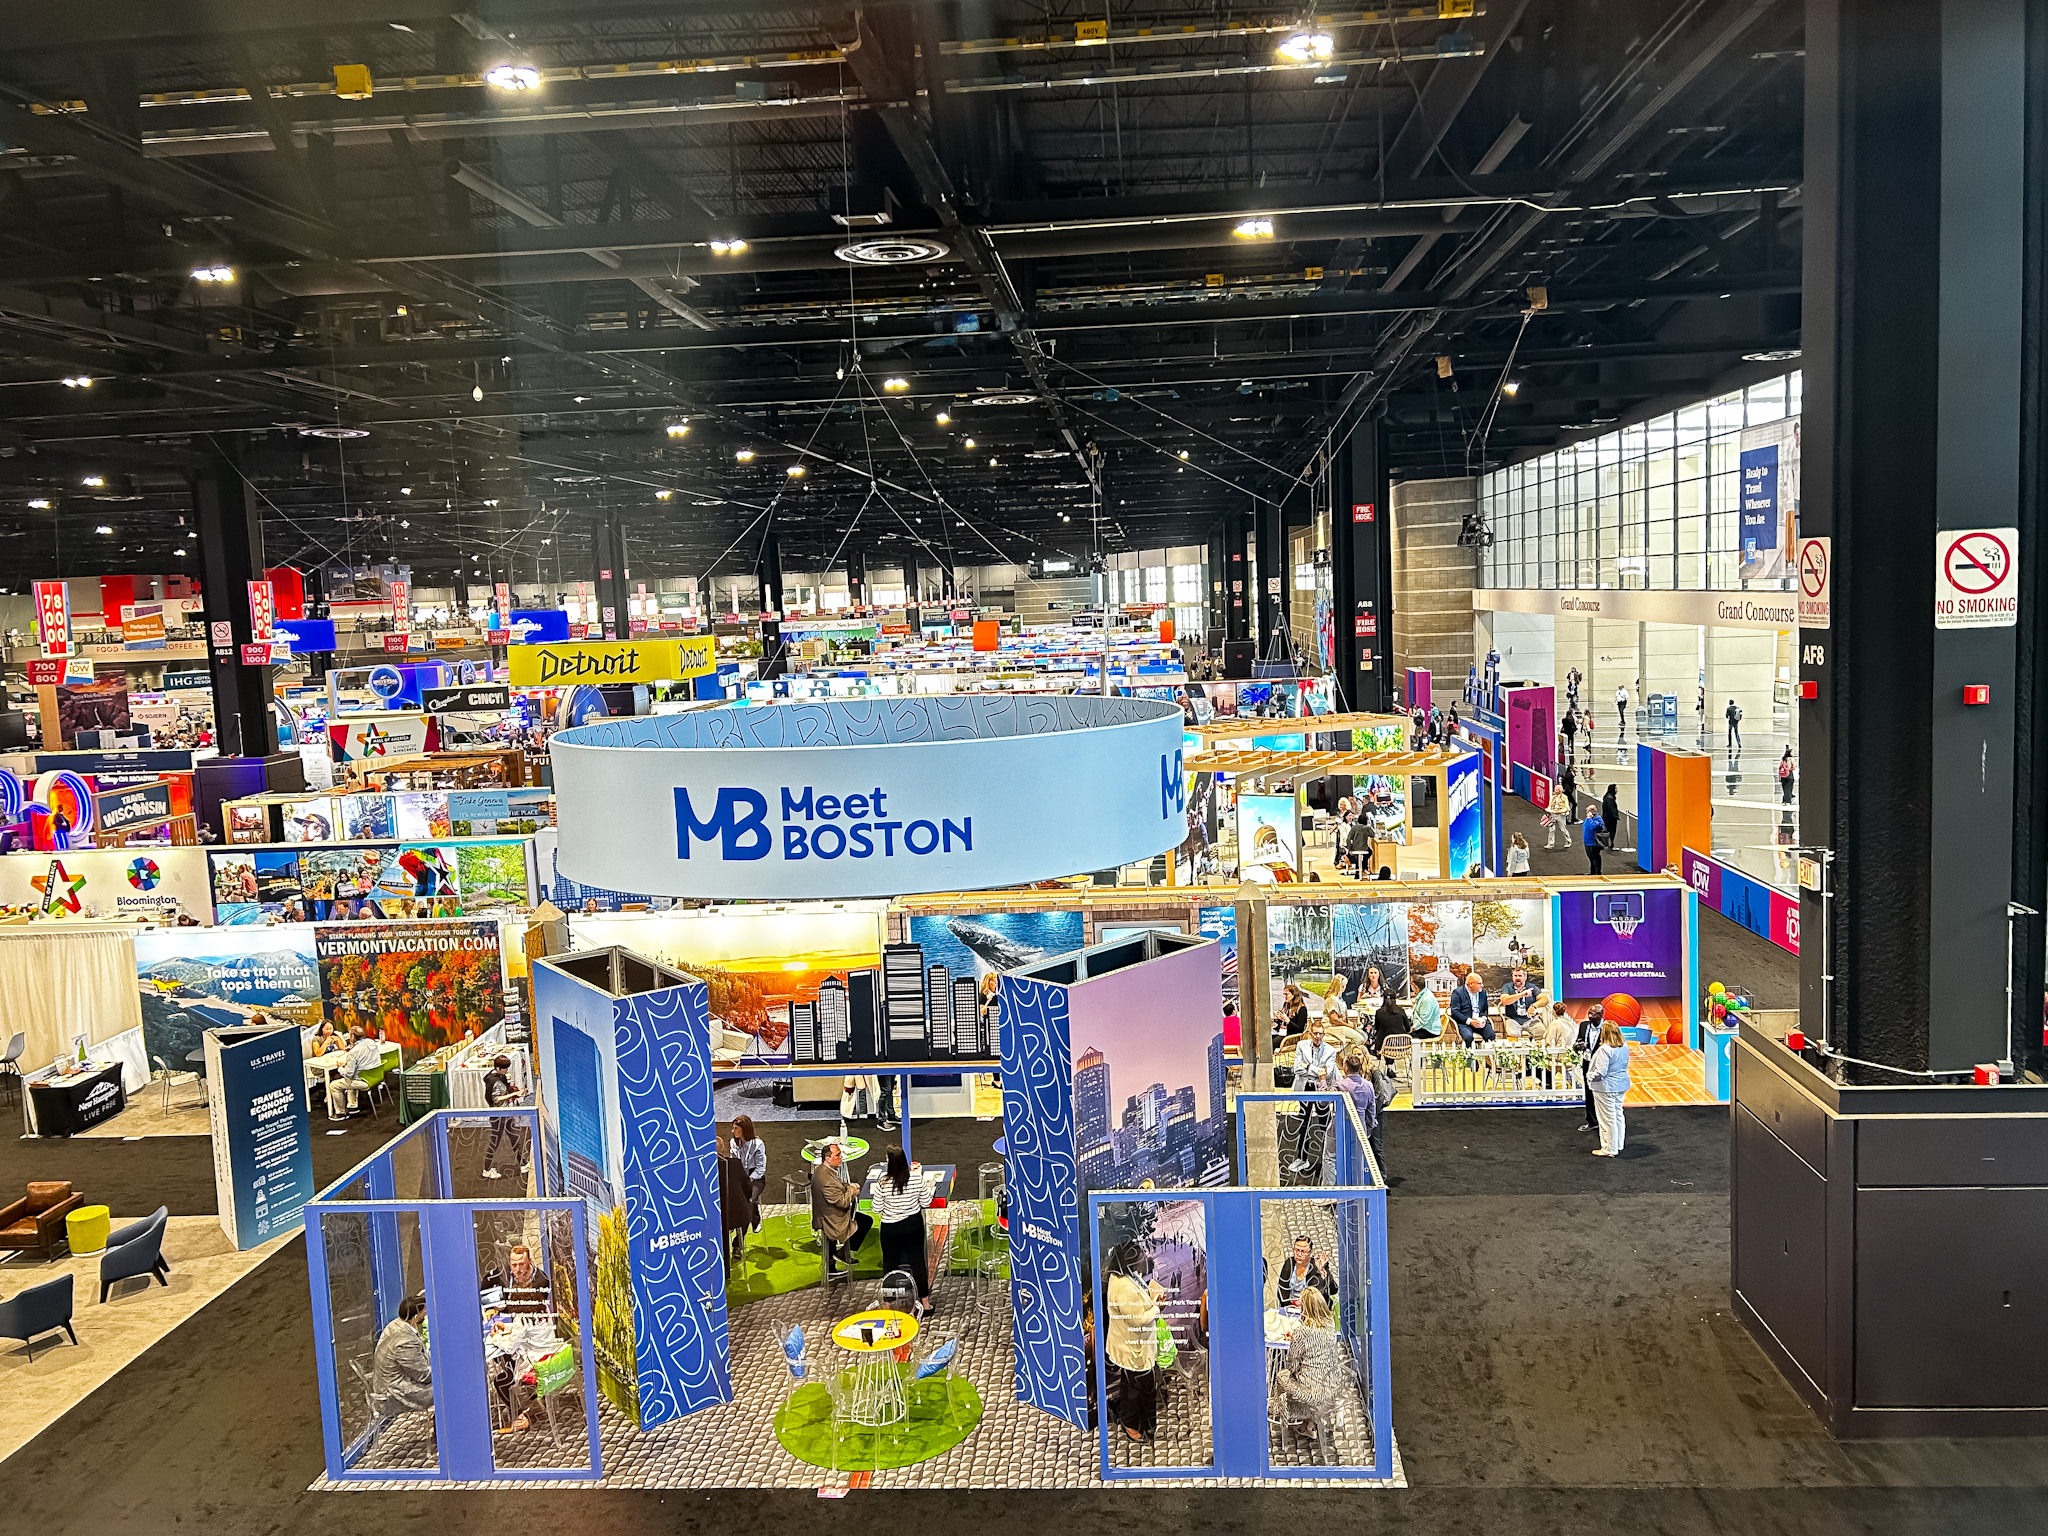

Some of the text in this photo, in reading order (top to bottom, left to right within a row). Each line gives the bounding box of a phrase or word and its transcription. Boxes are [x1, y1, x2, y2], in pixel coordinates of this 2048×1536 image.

[1745, 466, 1768, 479] Ready to
[1745, 482, 1762, 495] Travel
[1745, 498, 1771, 510] Whenever
[1355, 513, 1372, 521] HOSE
[1745, 514, 1765, 525] You Are
[1560, 597, 1600, 612] Grand Concourse
[1718, 600, 1795, 623] Grand Concourse
[1806, 601, 1829, 616] SMOKING
[1937, 597, 2016, 614] NO SMOKING
[1356, 618, 1375, 626] FIRE
[678, 643, 708, 676] Detroit
[1803, 644, 1825, 665] AF8
[35, 663, 56, 671] 700
[536, 647, 641, 683] Detroit
[35, 675, 57, 683] 800
[170, 676, 192, 686] IHG
[428, 691, 462, 710] Cleveland
[121, 793, 146, 804] TRAVEL
[459, 796, 476, 806] Lake
[673, 786, 887, 861] MB Meet
[783, 816, 973, 861] BOSTON
[117, 895, 177, 907] Bloomington
[318, 936, 498, 956] VERMONTVACATION.COM
[205, 964, 310, 979] Take a trip that
[1583, 961, 1654, 970] MASSACHUSETTS:
[221, 976, 314, 993] tops them all.
[285, 1001, 312, 1009] Hampshire
[250, 1049, 286, 1067] U.S. TRAVEL
[78, 1085, 120, 1112] New Hampshire
[251, 1086, 292, 1107] TRAVEL'S
[83, 1099, 117, 1121] LIVE FREE
[250, 1093, 295, 1117] ECONOMIC
[257, 1104, 289, 1122] IMPACT
[251, 1126, 265, 1135] When
[265, 1120, 280, 1131] Travel
[256, 1120, 293, 1138] America Thrives
[1022, 1221, 1037, 1239] MB
[650, 1230, 688, 1252] MB Meet
[670, 1231, 702, 1247] BOSTON
[1037, 1233, 1063, 1248] BOSTON
